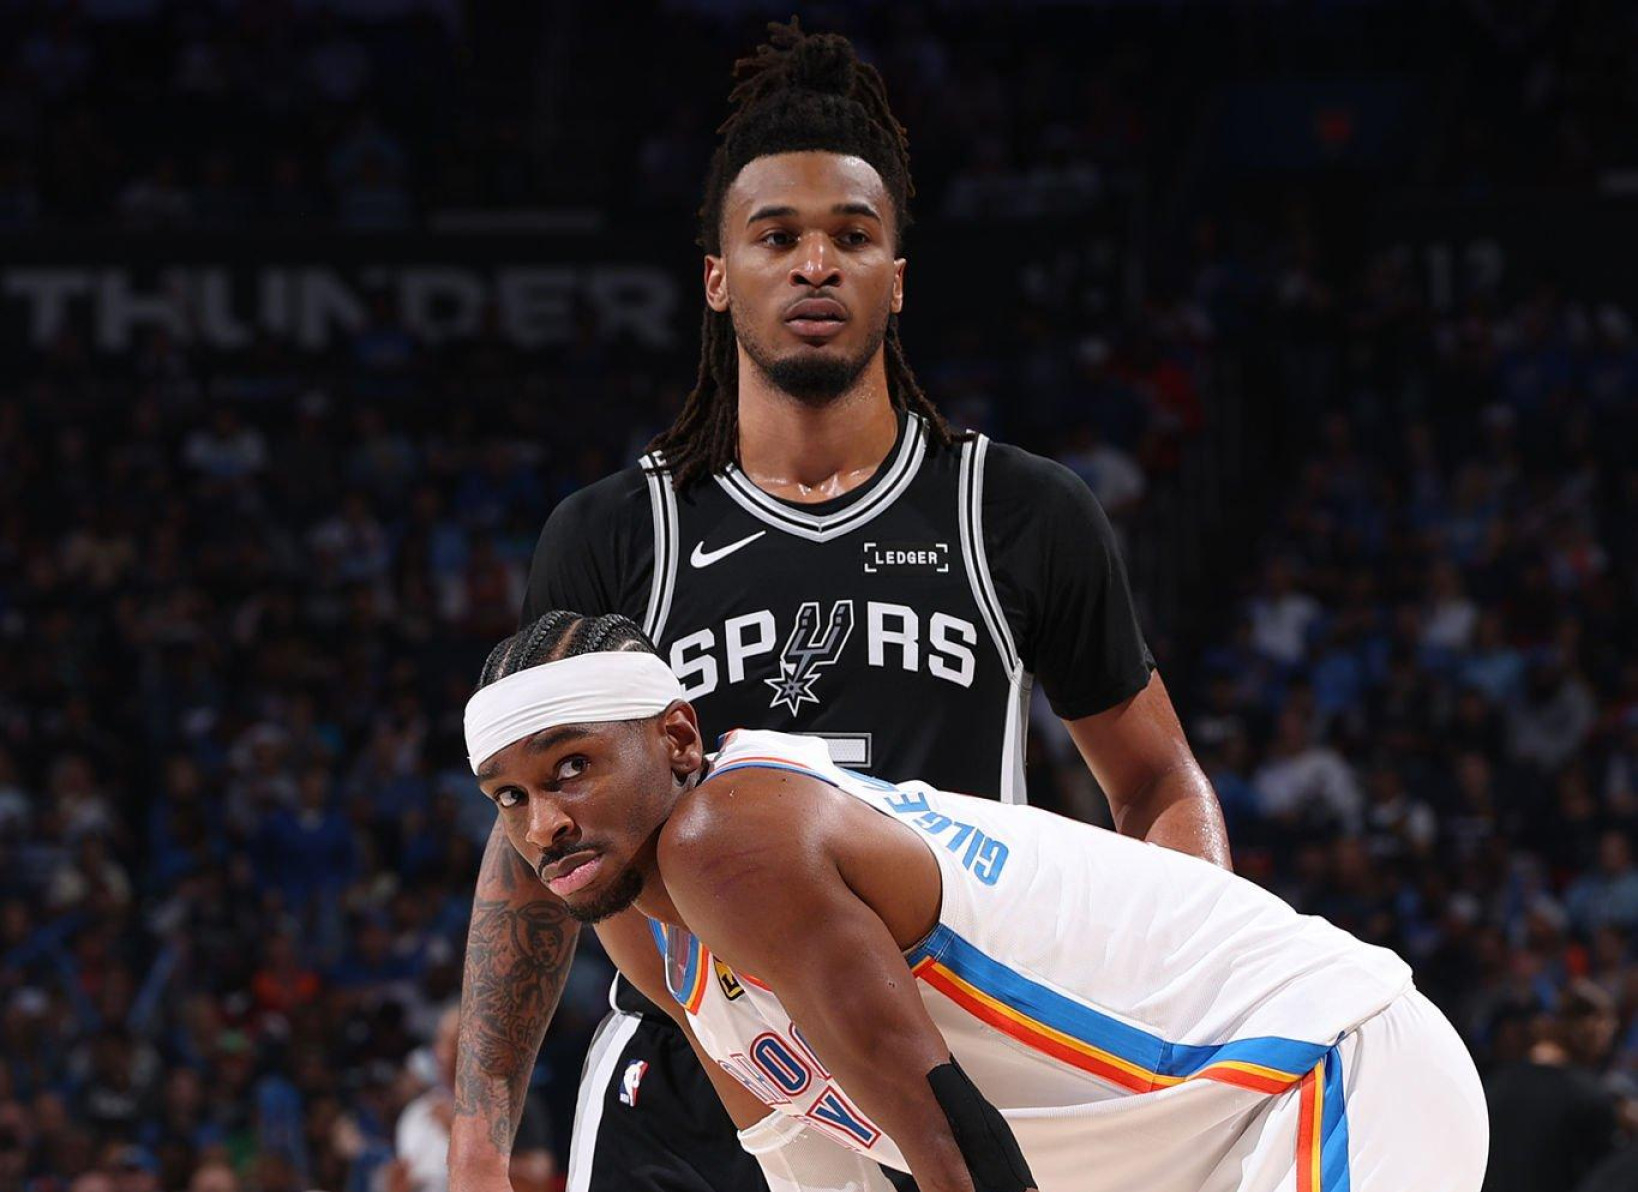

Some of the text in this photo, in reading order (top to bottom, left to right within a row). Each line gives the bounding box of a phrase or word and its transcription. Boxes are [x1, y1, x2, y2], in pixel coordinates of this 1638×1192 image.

[5, 264, 684, 350] THUNDER
[874, 551, 939, 566] LEDGER
[669, 600, 978, 717] SPURS
